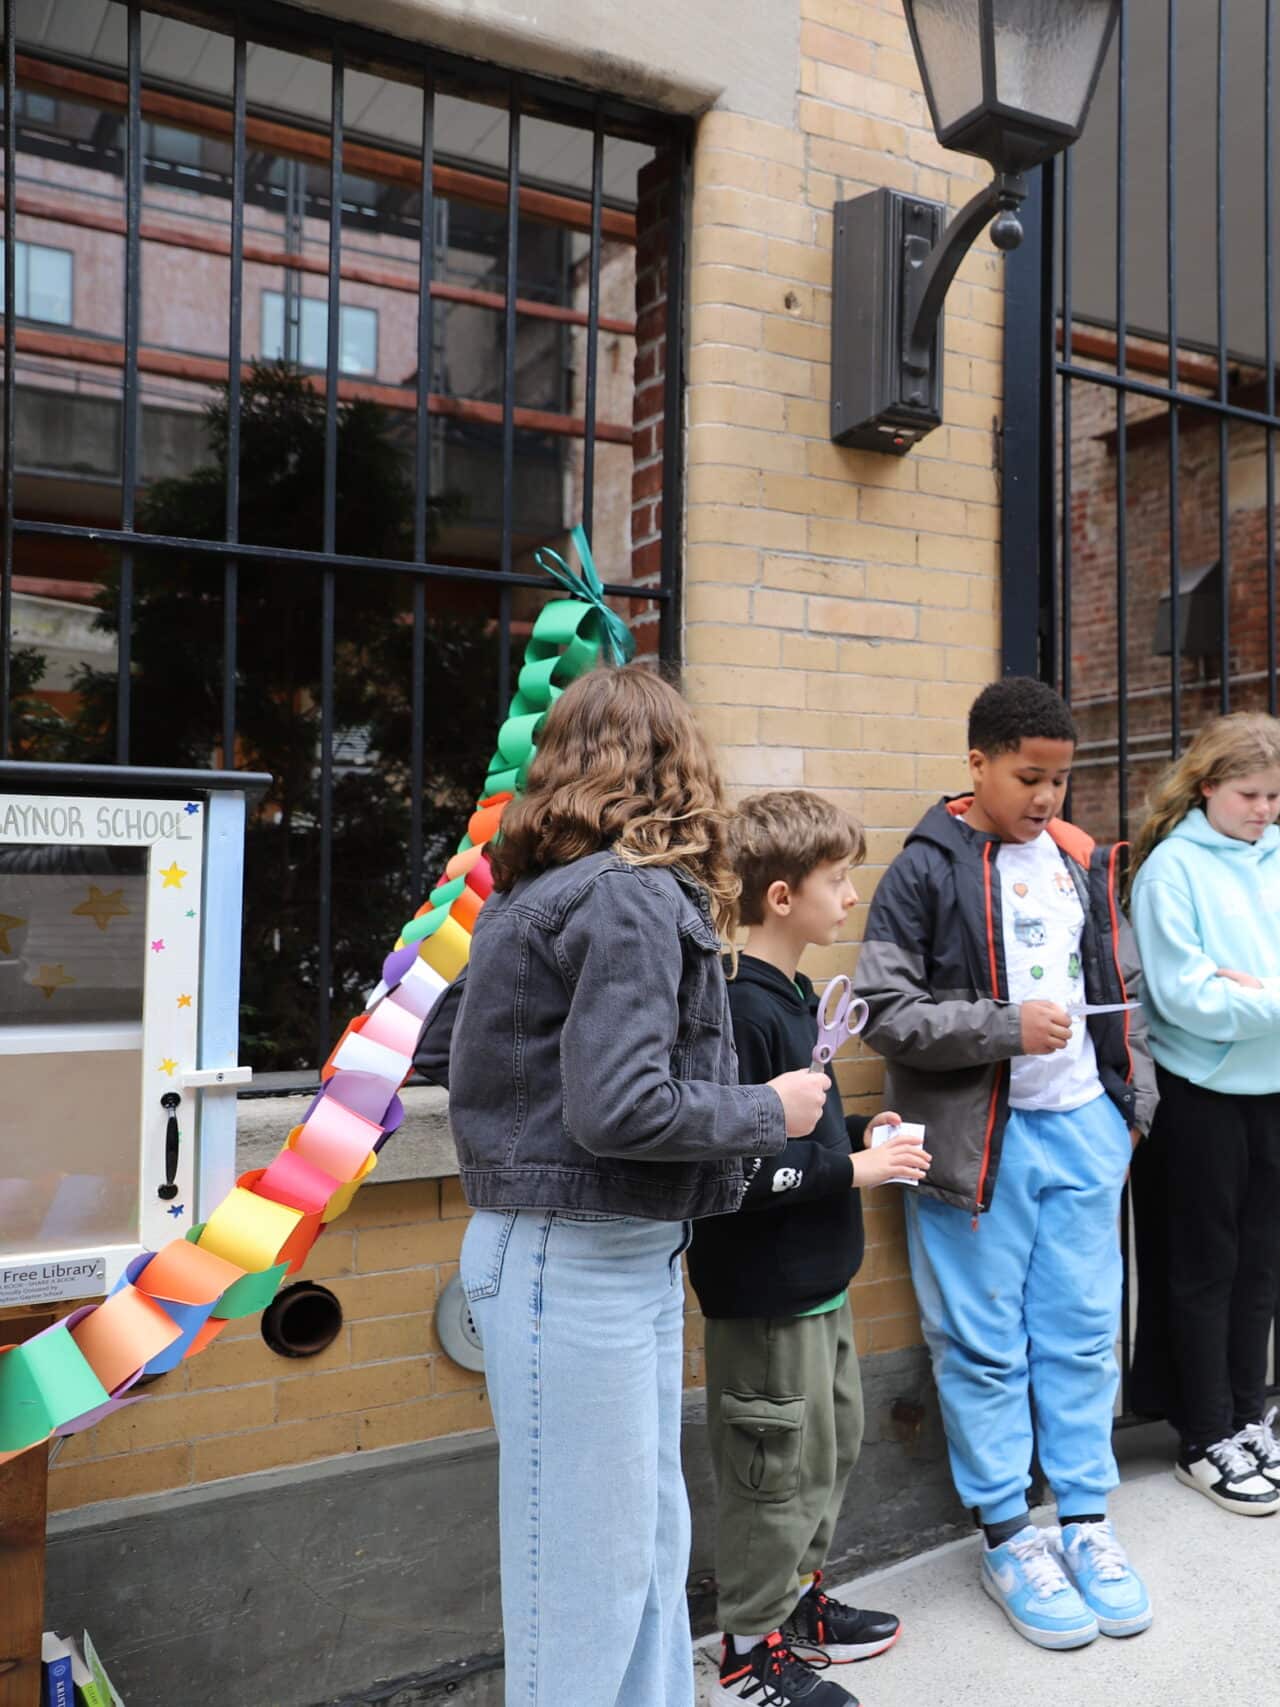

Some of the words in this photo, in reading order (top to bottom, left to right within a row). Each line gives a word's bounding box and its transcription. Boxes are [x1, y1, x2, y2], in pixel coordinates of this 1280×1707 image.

[0, 804, 84, 838] AYNOR
[96, 806, 192, 840] SCHOOL
[4, 1271, 38, 1283] Free
[43, 1264, 97, 1279] Library
